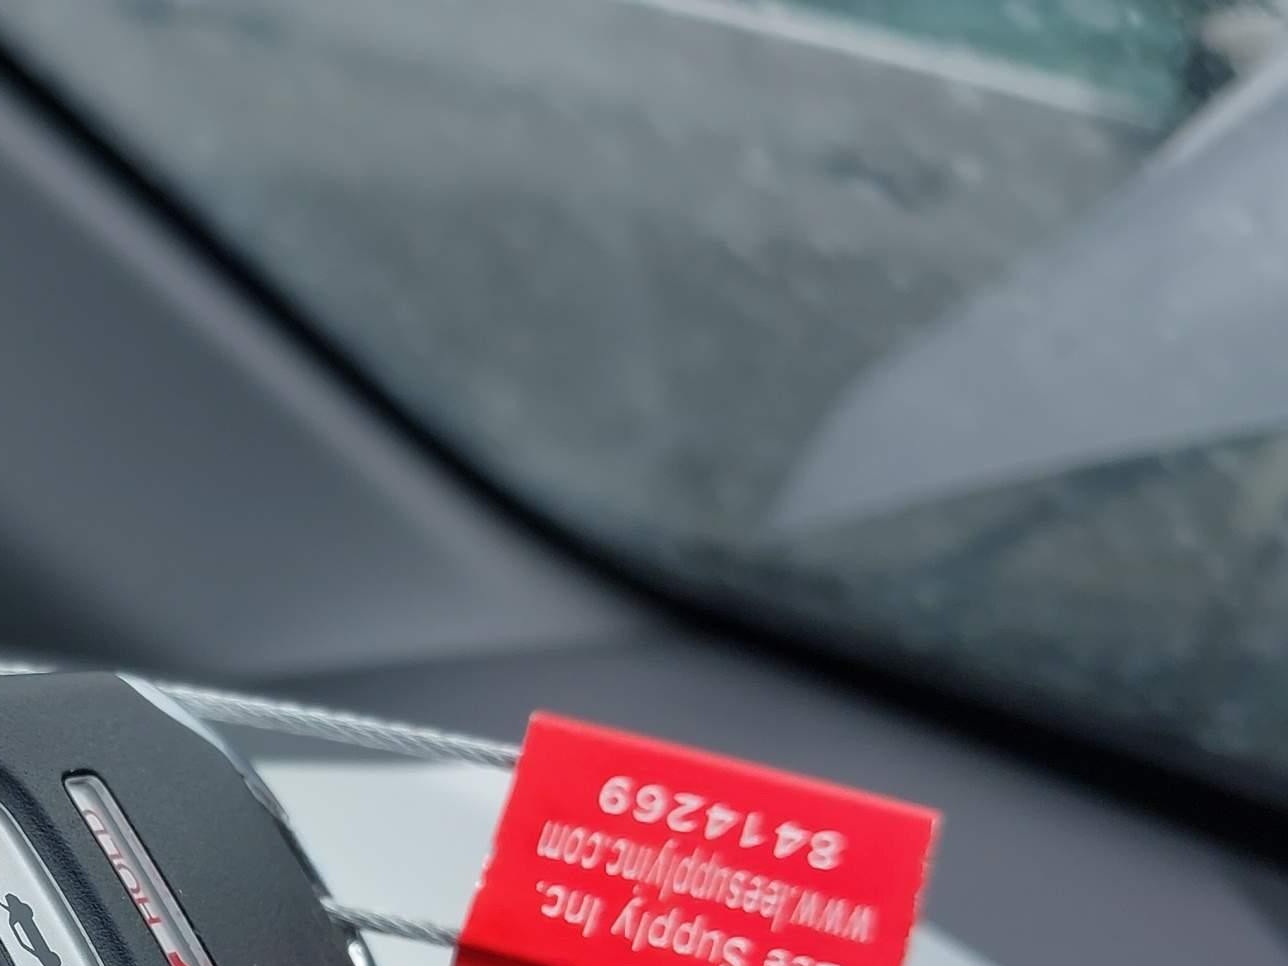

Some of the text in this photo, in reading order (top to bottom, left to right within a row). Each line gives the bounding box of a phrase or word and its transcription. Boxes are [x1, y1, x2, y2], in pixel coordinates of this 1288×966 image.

[598, 775, 848, 870] 8414269
[535, 880, 604, 938] Inc.
[536, 819, 880, 943] www.leesupplyinc.com
